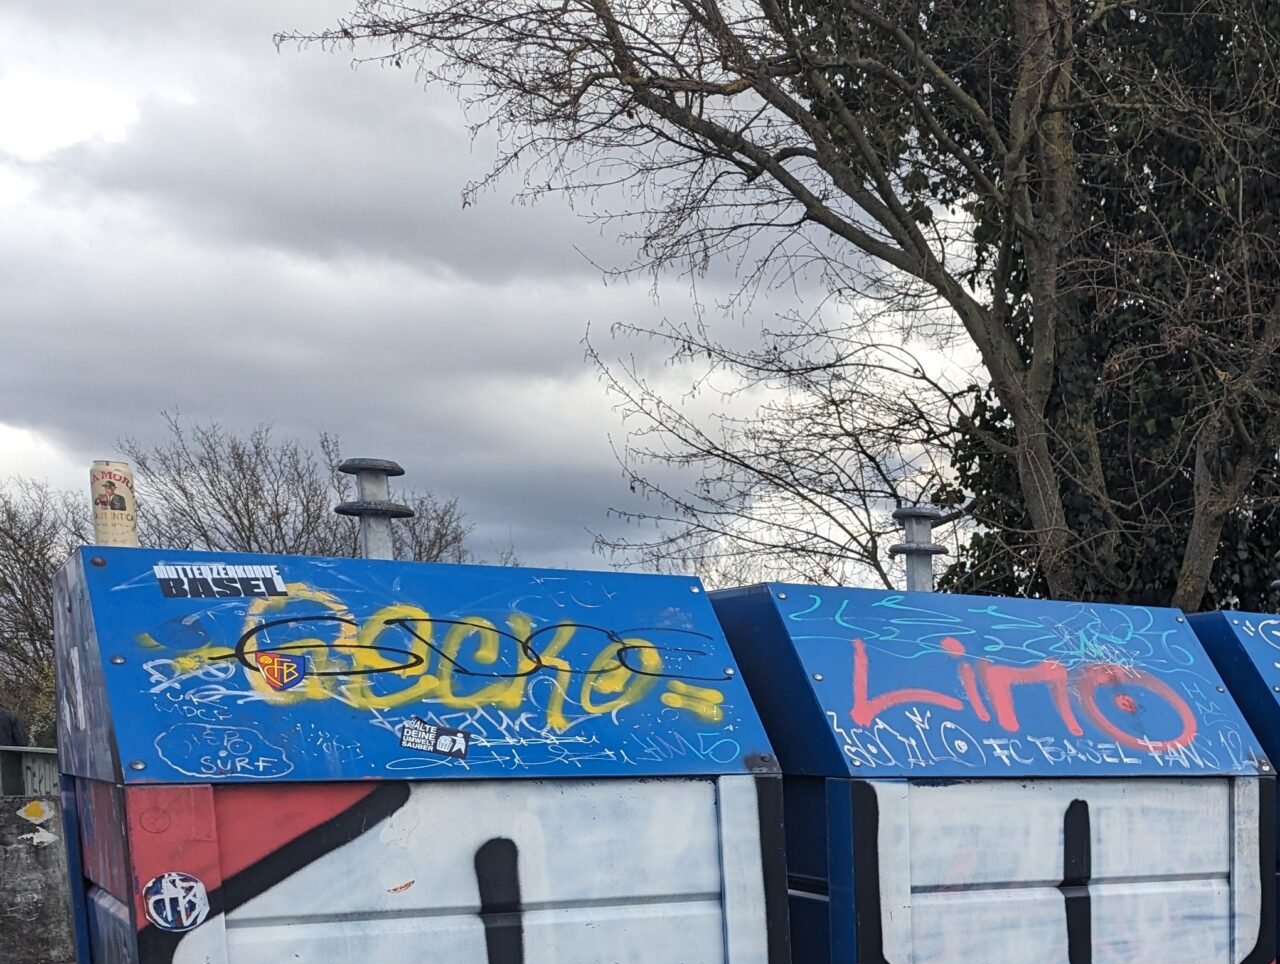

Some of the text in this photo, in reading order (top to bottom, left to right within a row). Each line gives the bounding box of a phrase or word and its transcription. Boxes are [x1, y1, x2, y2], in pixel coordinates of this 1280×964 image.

[158, 577, 289, 598] BASEL
[403, 735, 435, 746] UMWELT
[404, 728, 436, 741] DEINE
[401, 740, 433, 752] SAUBER
[983, 736, 1034, 767] FC
[1027, 735, 1142, 766] BASEL
[1137, 733, 1220, 770] FANS
[200, 756, 278, 774] SURF
